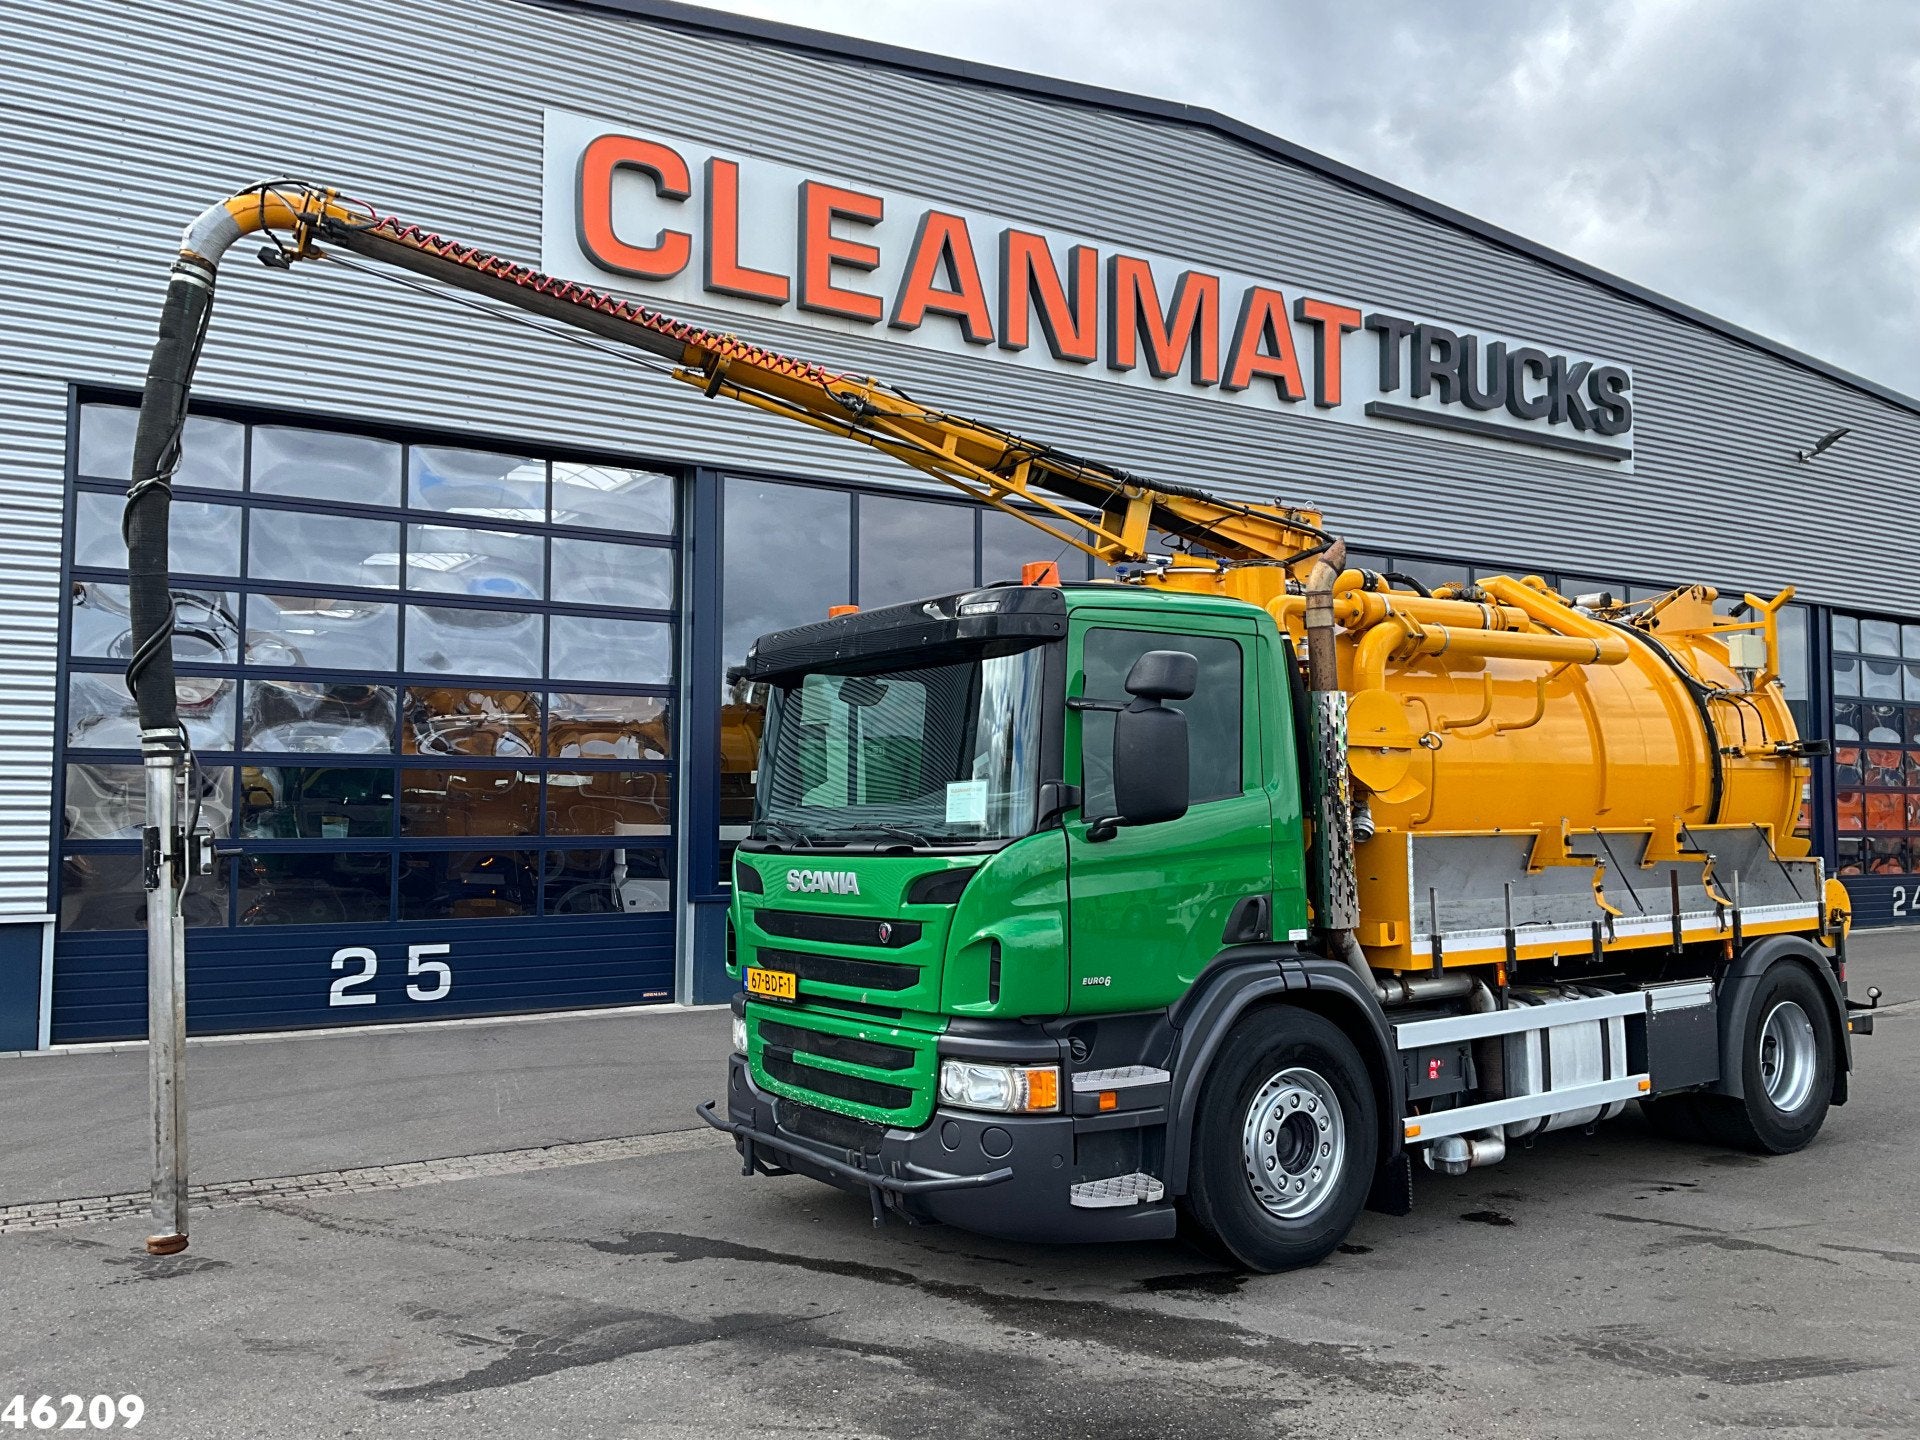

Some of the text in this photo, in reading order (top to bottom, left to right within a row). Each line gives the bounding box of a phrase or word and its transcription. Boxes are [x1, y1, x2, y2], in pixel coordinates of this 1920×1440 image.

[575, 133, 1632, 436] CLEANMAT TRUCKS
[786, 869, 860, 895] SCANIA
[751, 972, 791, 994] 67-BDF-1
